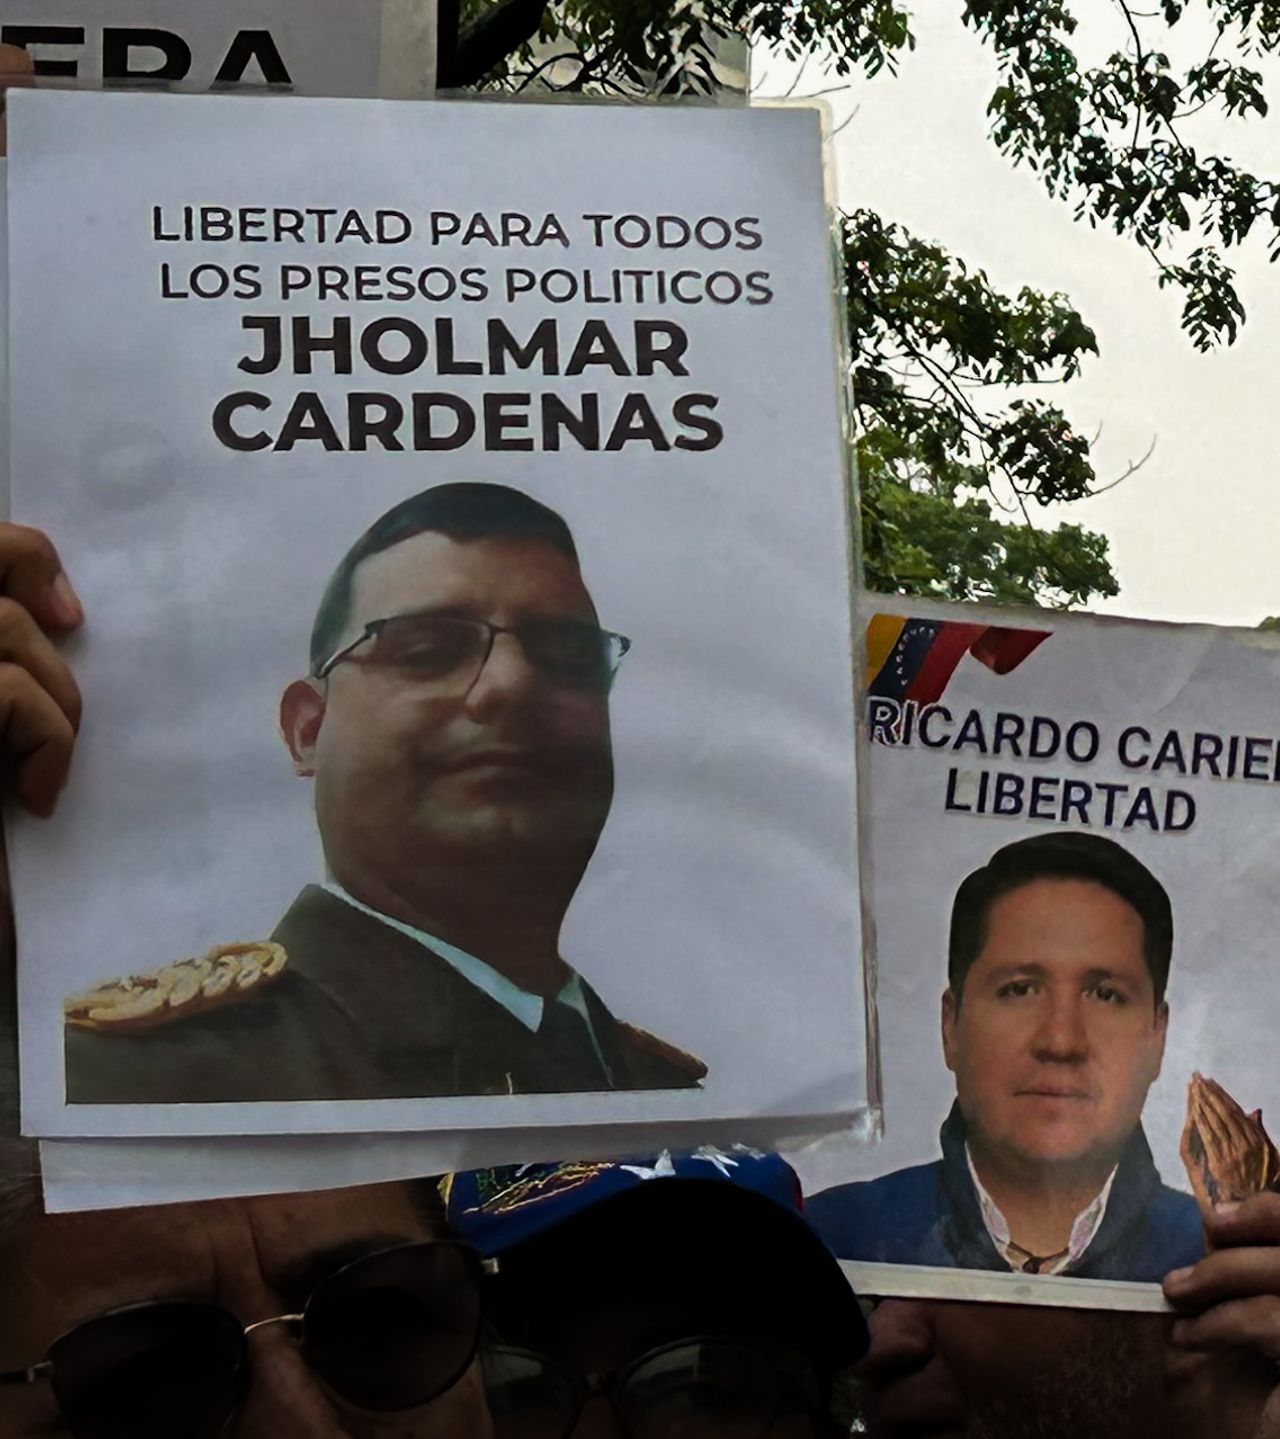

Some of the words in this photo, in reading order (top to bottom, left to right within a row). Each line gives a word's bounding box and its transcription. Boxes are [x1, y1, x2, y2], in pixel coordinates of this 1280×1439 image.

[152, 205, 413, 246] LIBERTAD
[430, 211, 570, 249] PARA
[582, 213, 762, 251] TODOS
[160, 263, 262, 300] LOS
[280, 265, 488, 302] PRESOS
[505, 268, 774, 306] POLITICOS
[237, 316, 690, 377] JHOLMAR
[211, 390, 725, 453] CARDENAS
[867, 698, 1100, 764] RICARDO
[944, 768, 1197, 833] LIBERTAD
